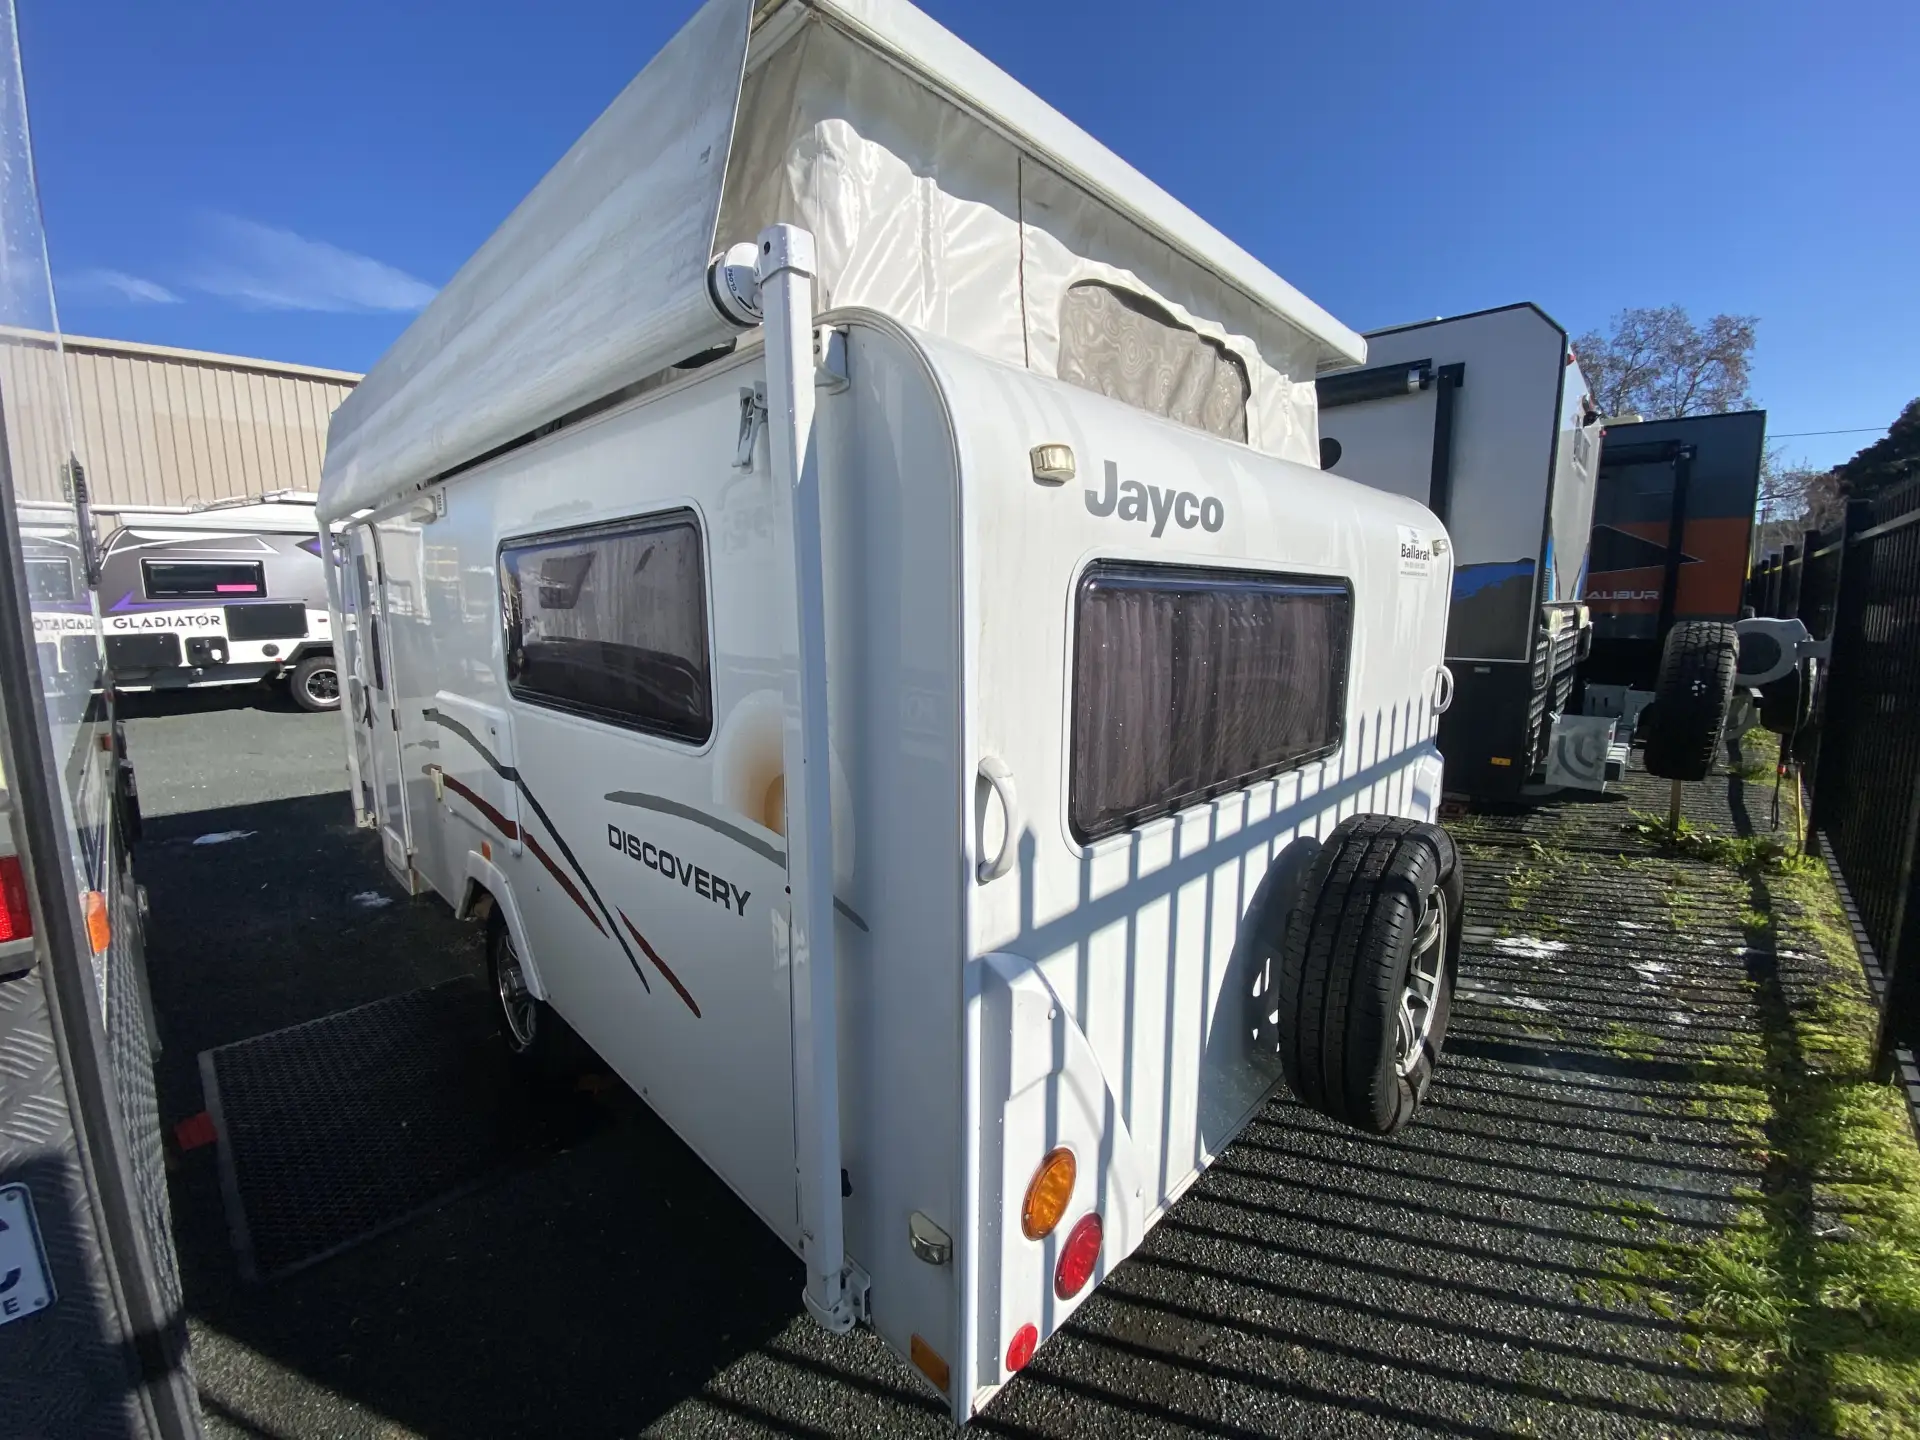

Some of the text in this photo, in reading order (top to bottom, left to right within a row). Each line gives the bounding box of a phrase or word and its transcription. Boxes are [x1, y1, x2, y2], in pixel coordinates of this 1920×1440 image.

[1084, 459, 1225, 539] Jayco
[1401, 543, 1430, 561] Ballarat
[1585, 590, 1660, 600] ALIBUR
[113, 613, 221, 629] GLADIATOR
[607, 823, 751, 917] DISCOVERY
